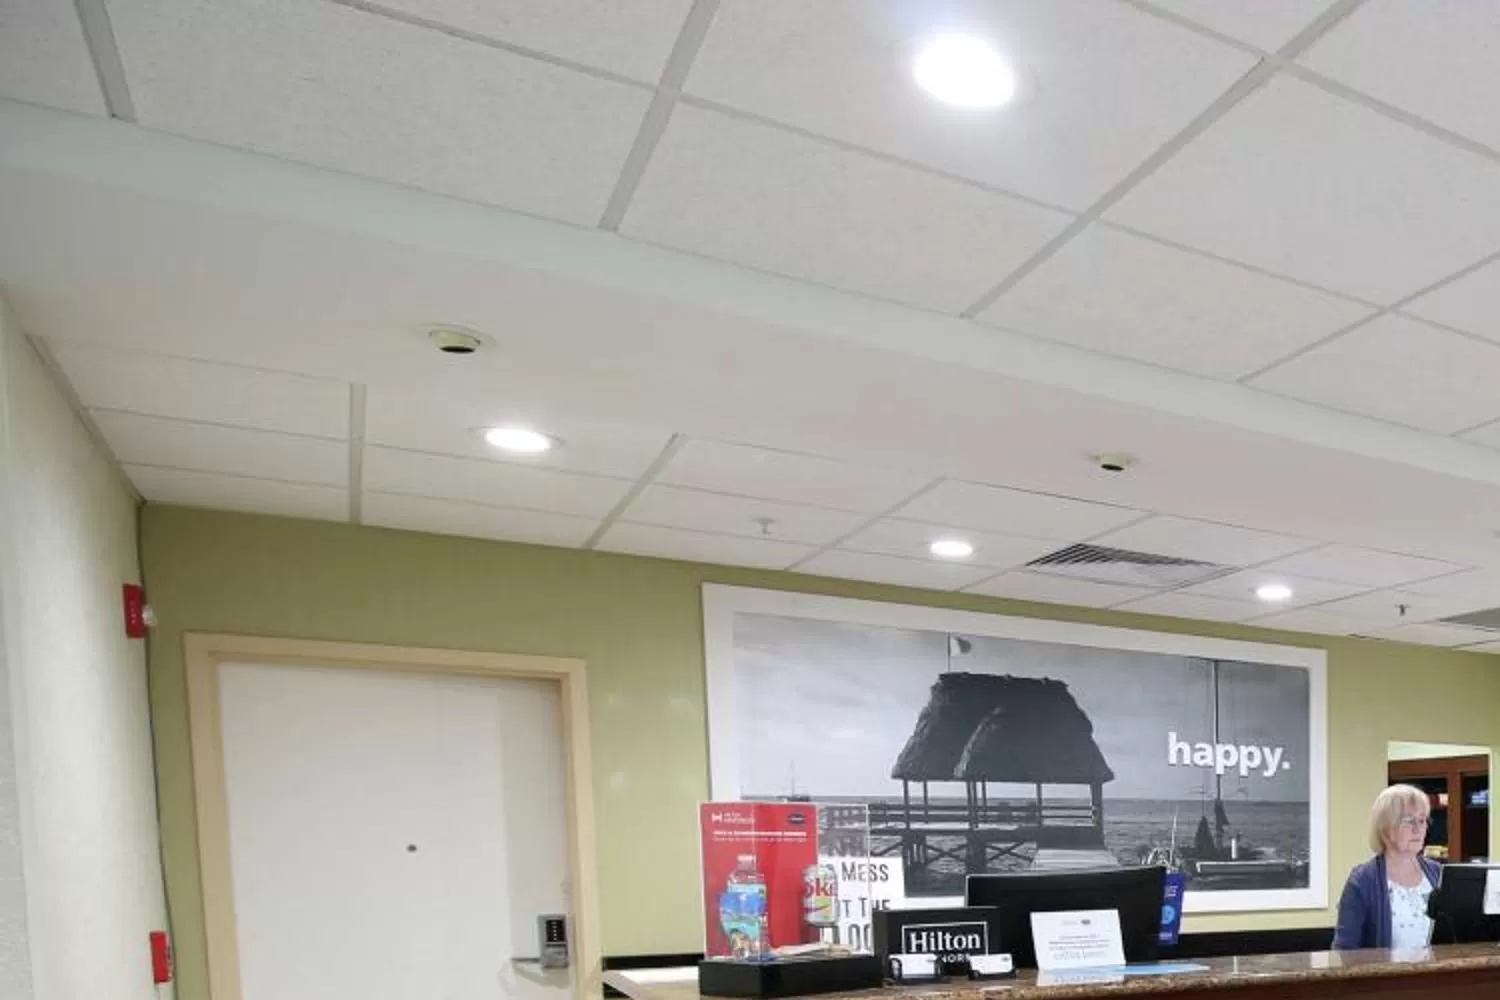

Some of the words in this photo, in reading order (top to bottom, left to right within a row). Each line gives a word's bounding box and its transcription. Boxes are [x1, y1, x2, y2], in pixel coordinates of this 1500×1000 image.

[1168, 731, 1291, 777] happy.
[841, 861, 889, 881] MESS
[910, 931, 981, 952] Hilton
